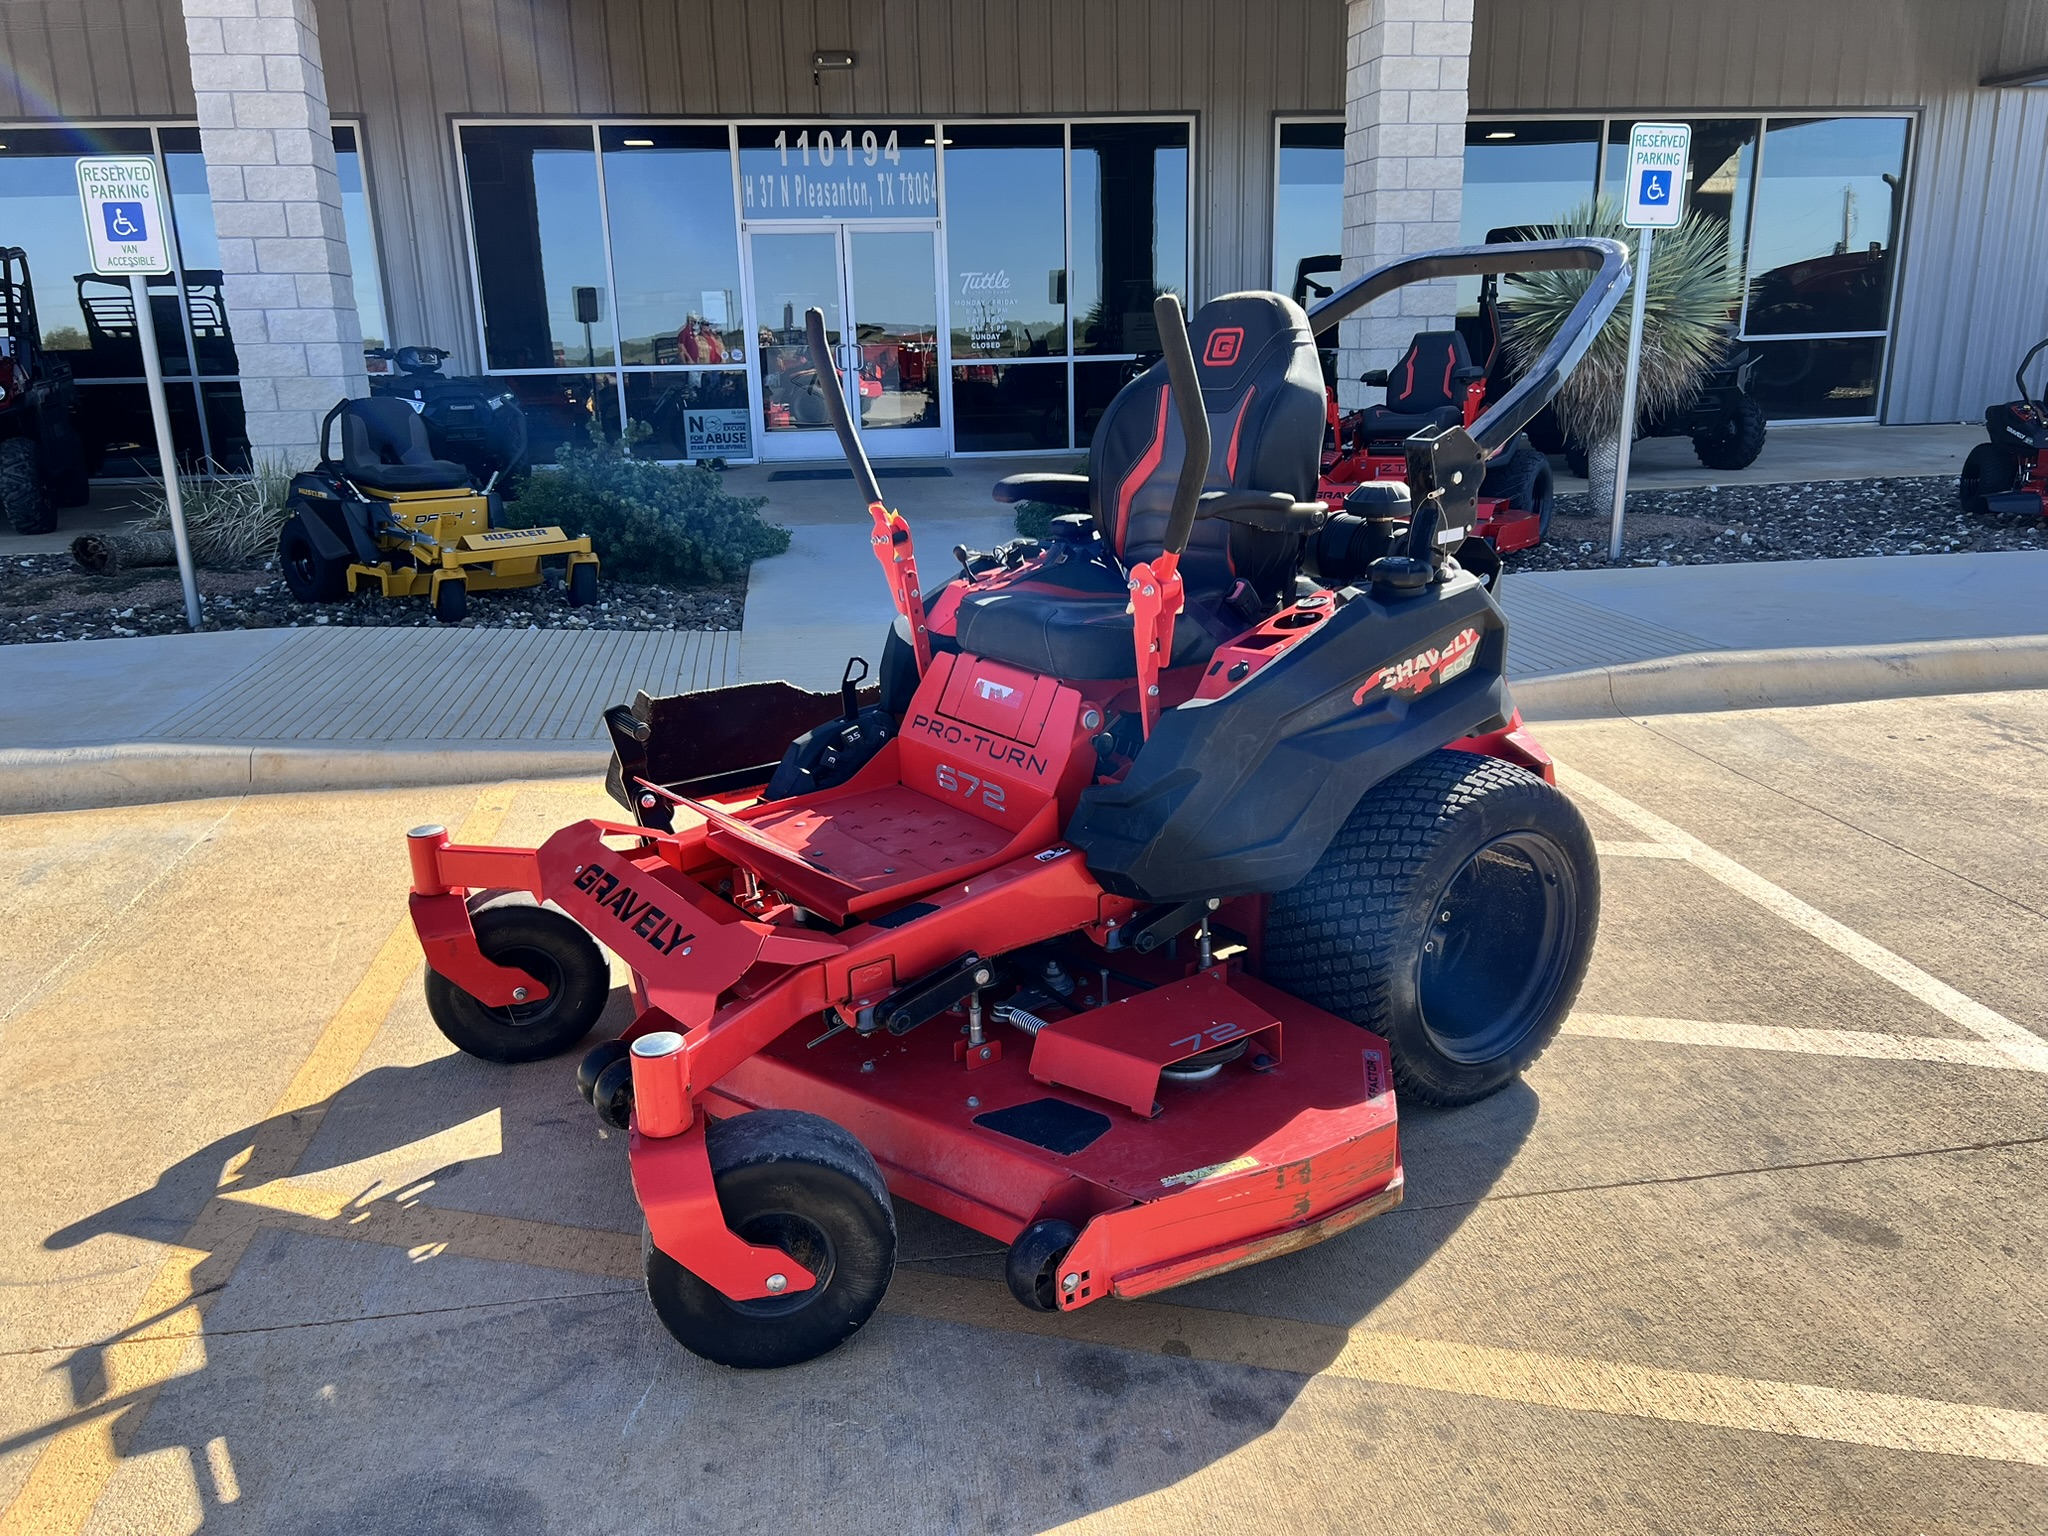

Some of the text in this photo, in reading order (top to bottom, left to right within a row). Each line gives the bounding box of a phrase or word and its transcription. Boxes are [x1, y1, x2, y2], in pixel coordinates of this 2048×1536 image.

[1635, 134, 1686, 148] RESERVED
[774, 130, 900, 167] 110194
[1636, 152, 1681, 166] PARKING
[83, 166, 151, 182] RESERVED
[90, 184, 150, 199] PARKING
[759, 174, 774, 208] 37
[780, 174, 790, 208] N
[794, 174, 873, 214] Pleasanton,
[877, 172, 895, 206] TX
[899, 171, 937, 206] 78064
[121, 244, 138, 254] VAN
[107, 256, 156, 267] ACCESSIBLE
[959, 269, 1011, 296] Tuttle
[954, 299, 986, 307] MONDAY
[966, 316, 1005, 324] SATURDAY
[970, 333, 1001, 341] SUNDAY
[706, 432, 747, 444] ABUSE
[482, 528, 548, 542] HUSTLER
[912, 714, 1048, 776] PRO-TURN
[935, 763, 1006, 813] 672
[573, 863, 697, 957] GRAVELY
[1169, 1022, 1246, 1051] 72
